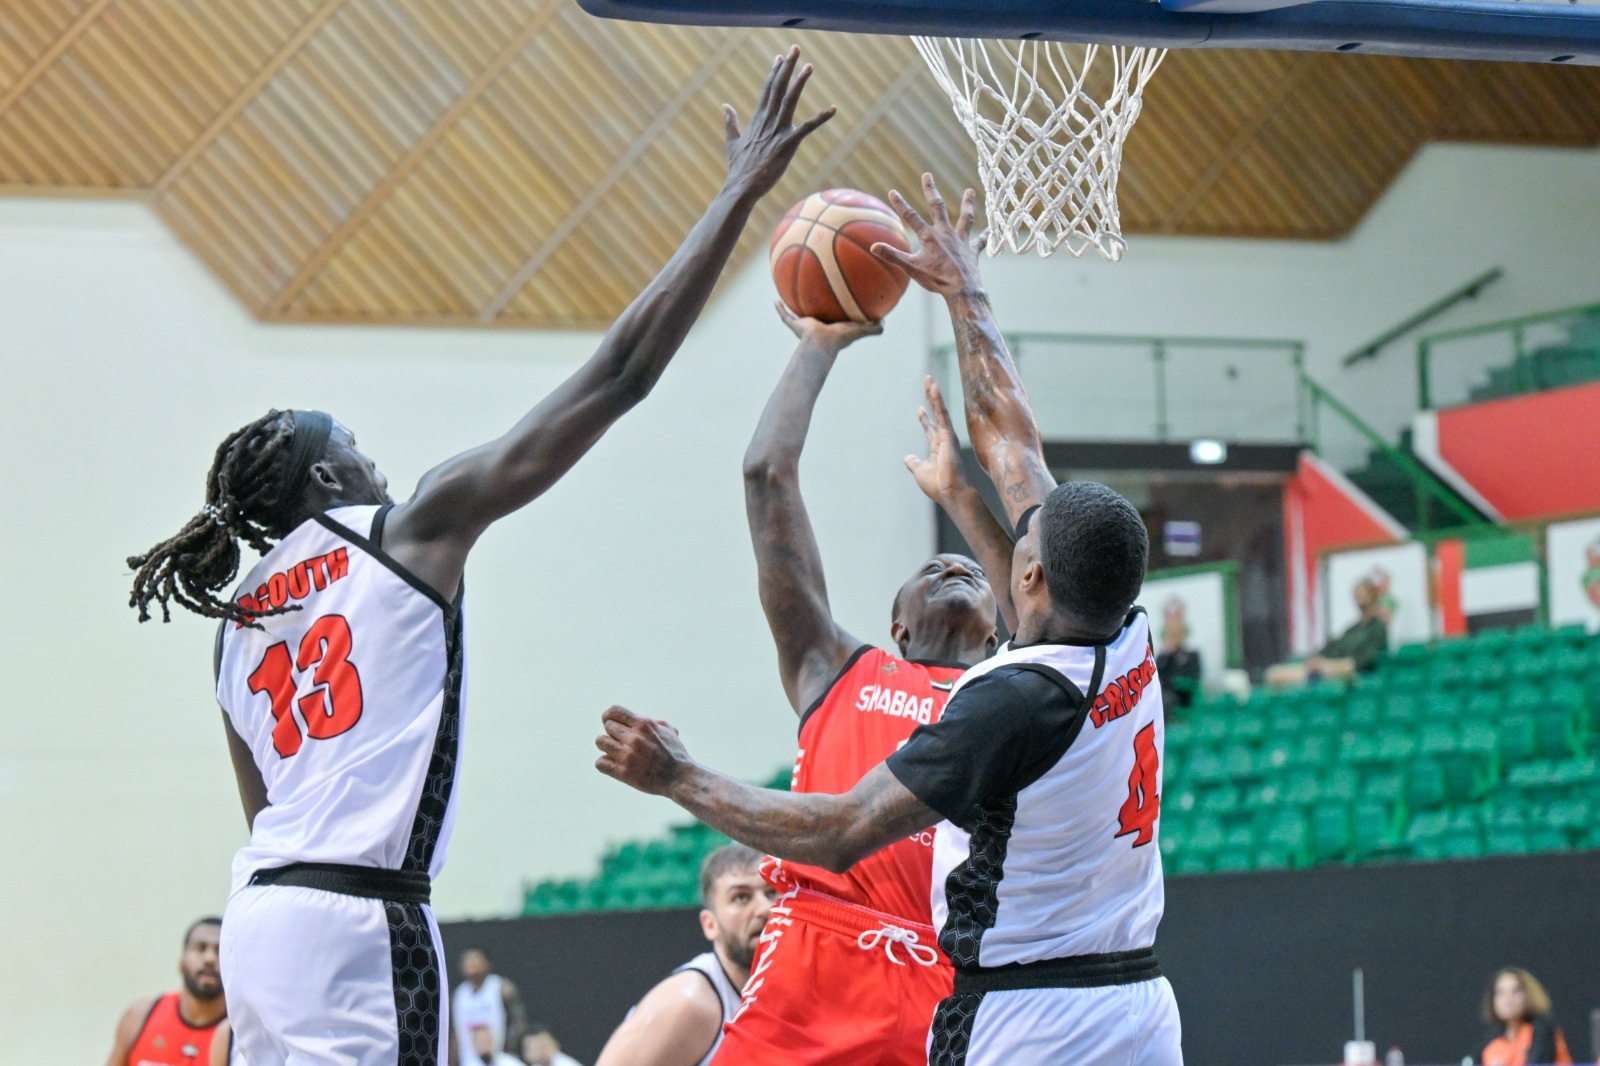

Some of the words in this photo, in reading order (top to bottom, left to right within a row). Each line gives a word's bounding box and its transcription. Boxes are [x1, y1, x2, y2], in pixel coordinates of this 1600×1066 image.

[247, 613, 364, 760] 13
[855, 683, 934, 725] SHABAB
[1113, 719, 1160, 849] 4
